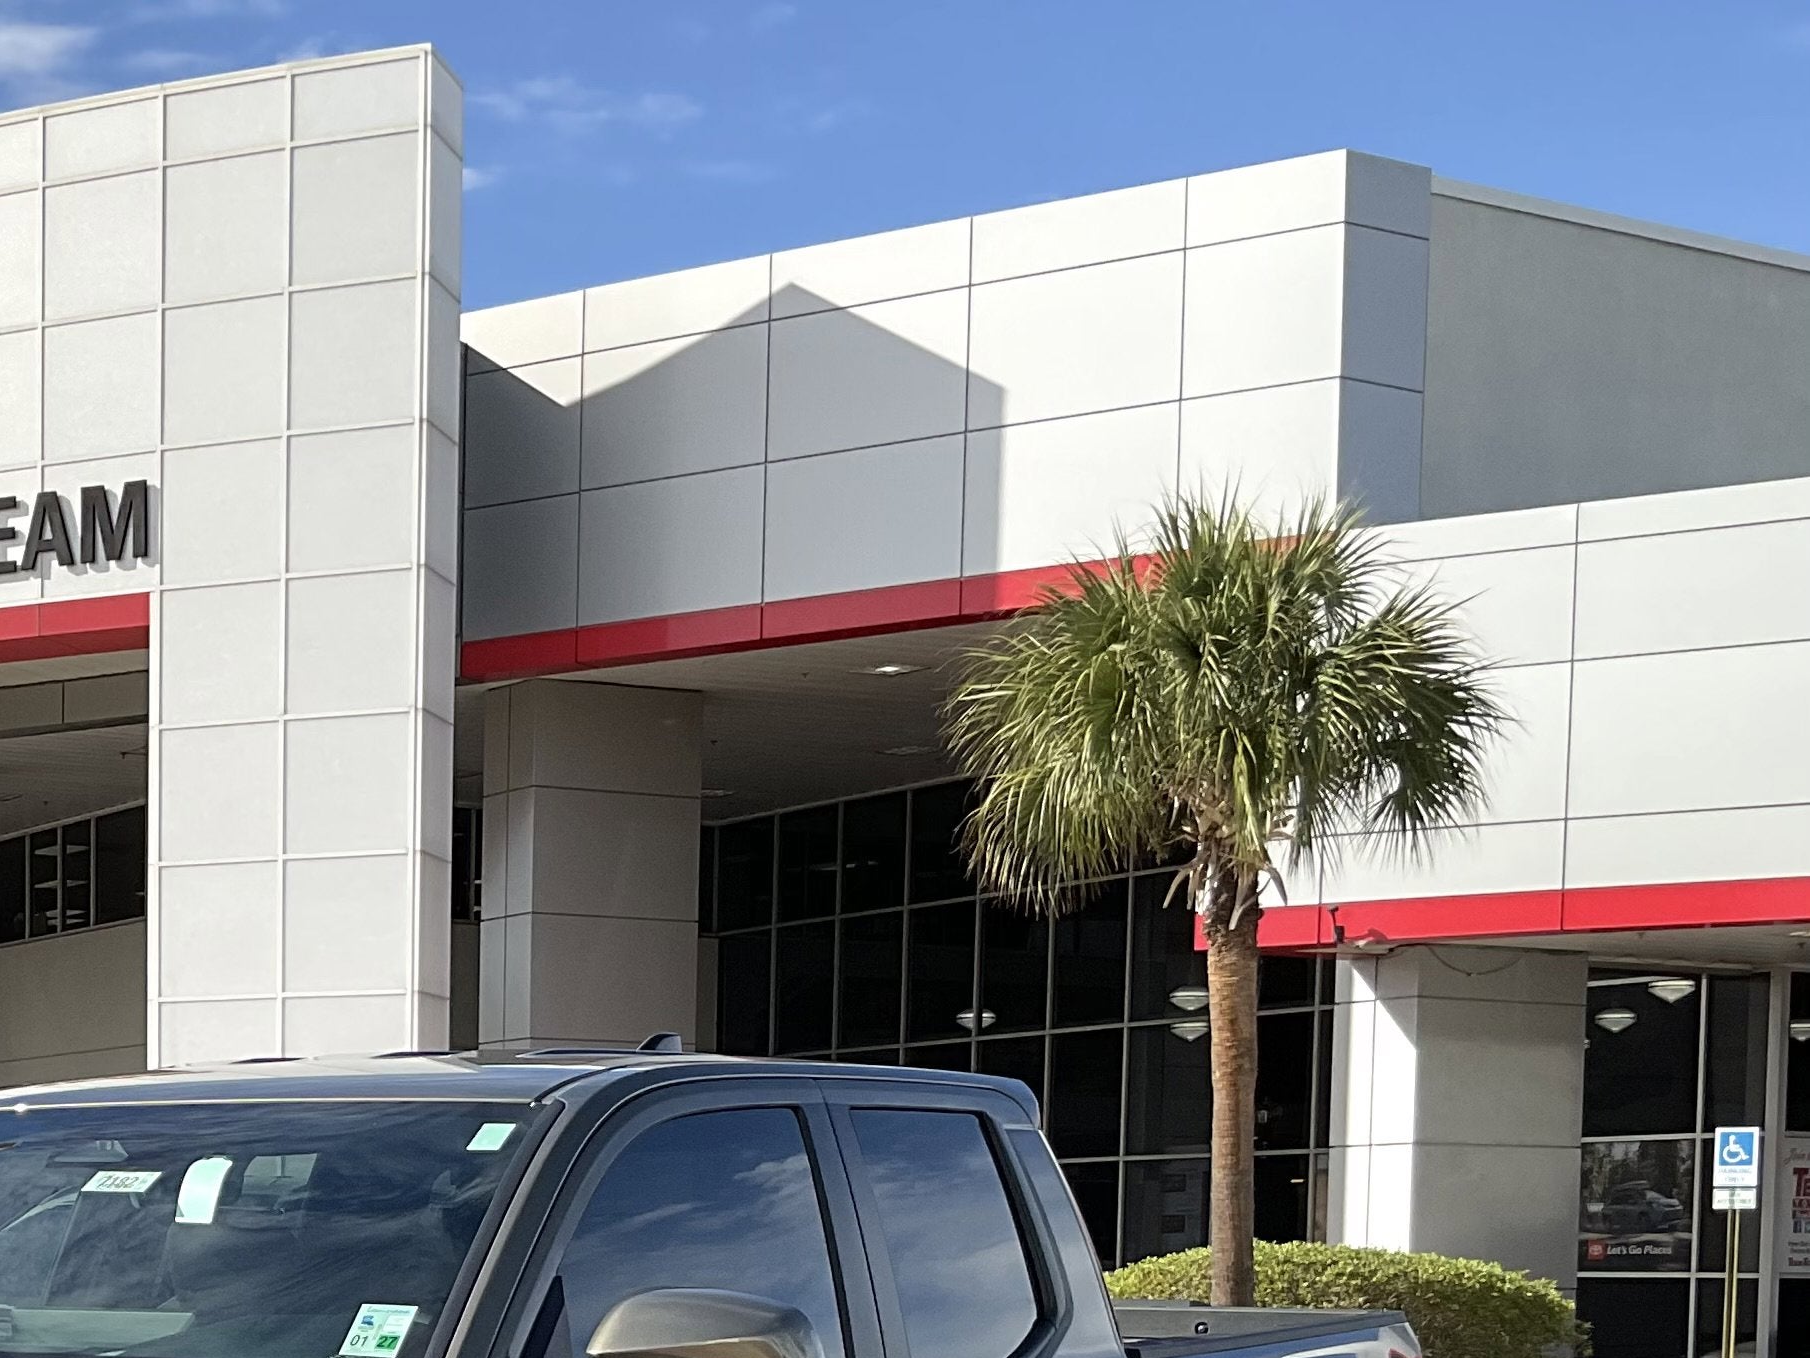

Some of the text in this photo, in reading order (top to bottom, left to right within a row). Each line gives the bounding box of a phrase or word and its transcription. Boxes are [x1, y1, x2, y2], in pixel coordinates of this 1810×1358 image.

[1628, 1245, 1643, 1255] Go
[350, 1335, 369, 1347] 01
[376, 1336, 399, 1348] 27
